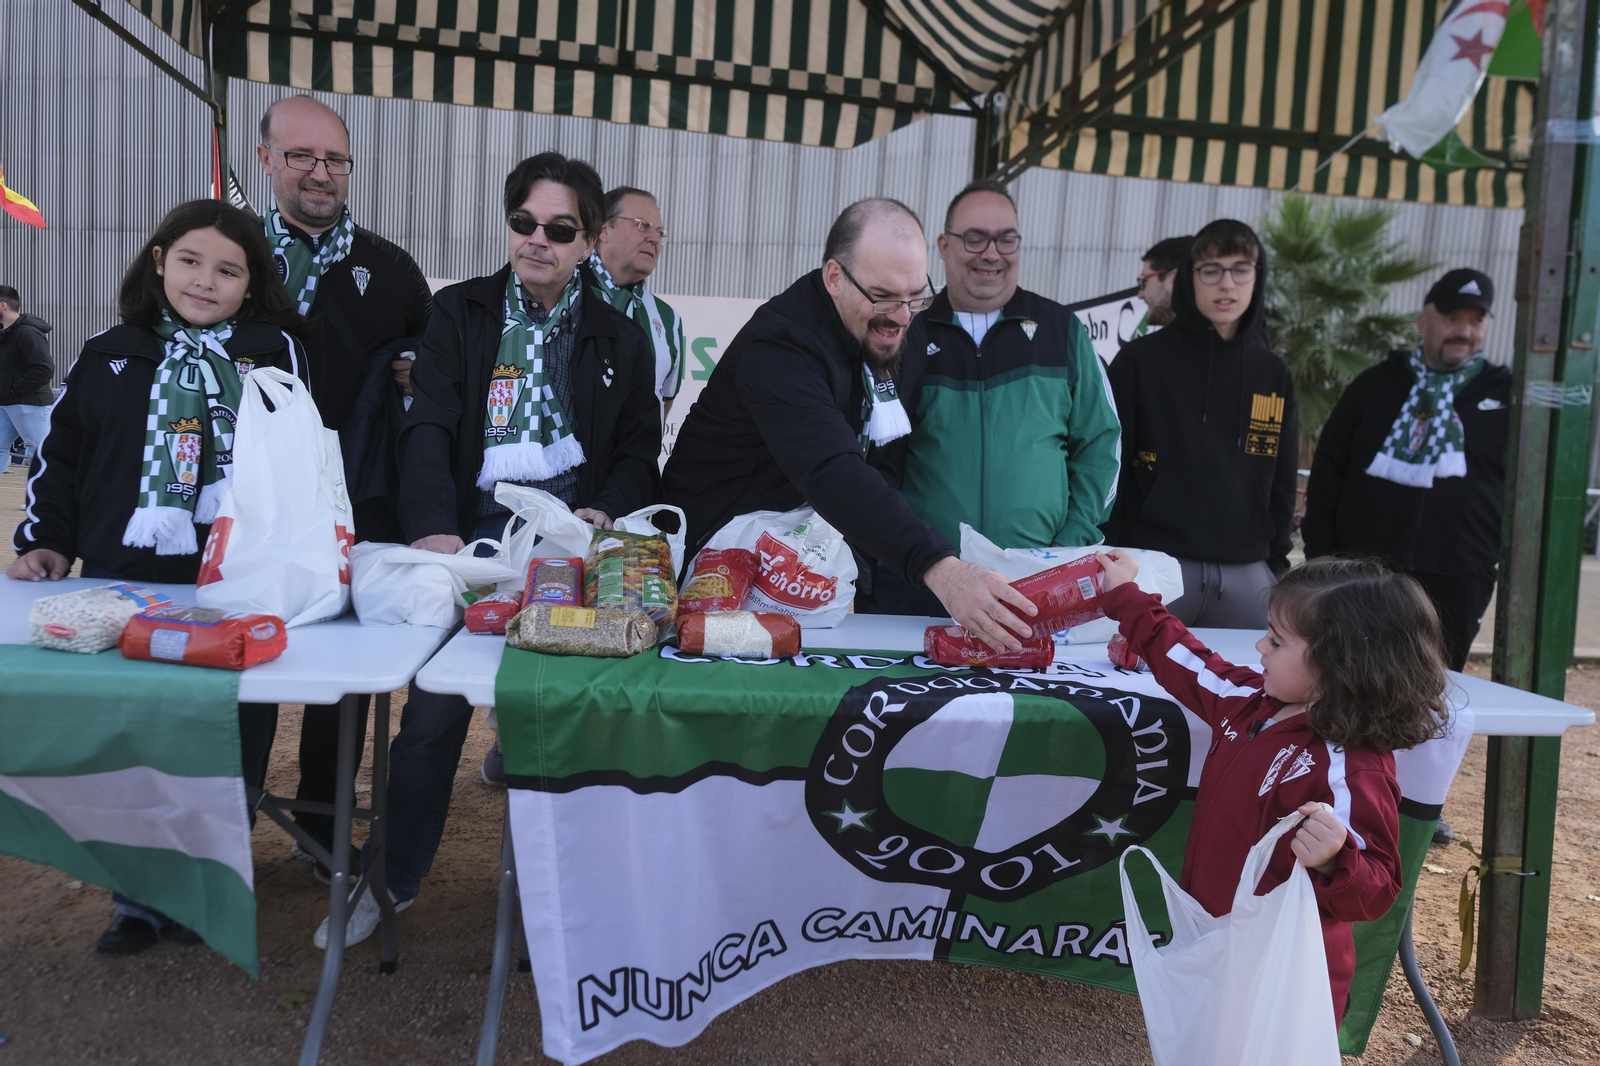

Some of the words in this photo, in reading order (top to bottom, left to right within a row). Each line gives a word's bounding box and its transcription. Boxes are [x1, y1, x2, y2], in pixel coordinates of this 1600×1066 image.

[874, 380, 896, 393] 195
[484, 426, 517, 438] 1954
[166, 483, 198, 497] 195
[768, 570, 832, 602] ahorro
[855, 835, 1082, 891] 2001
[578, 919, 787, 1031] NUNCA
[801, 905, 1167, 968] CAMINARÁ
